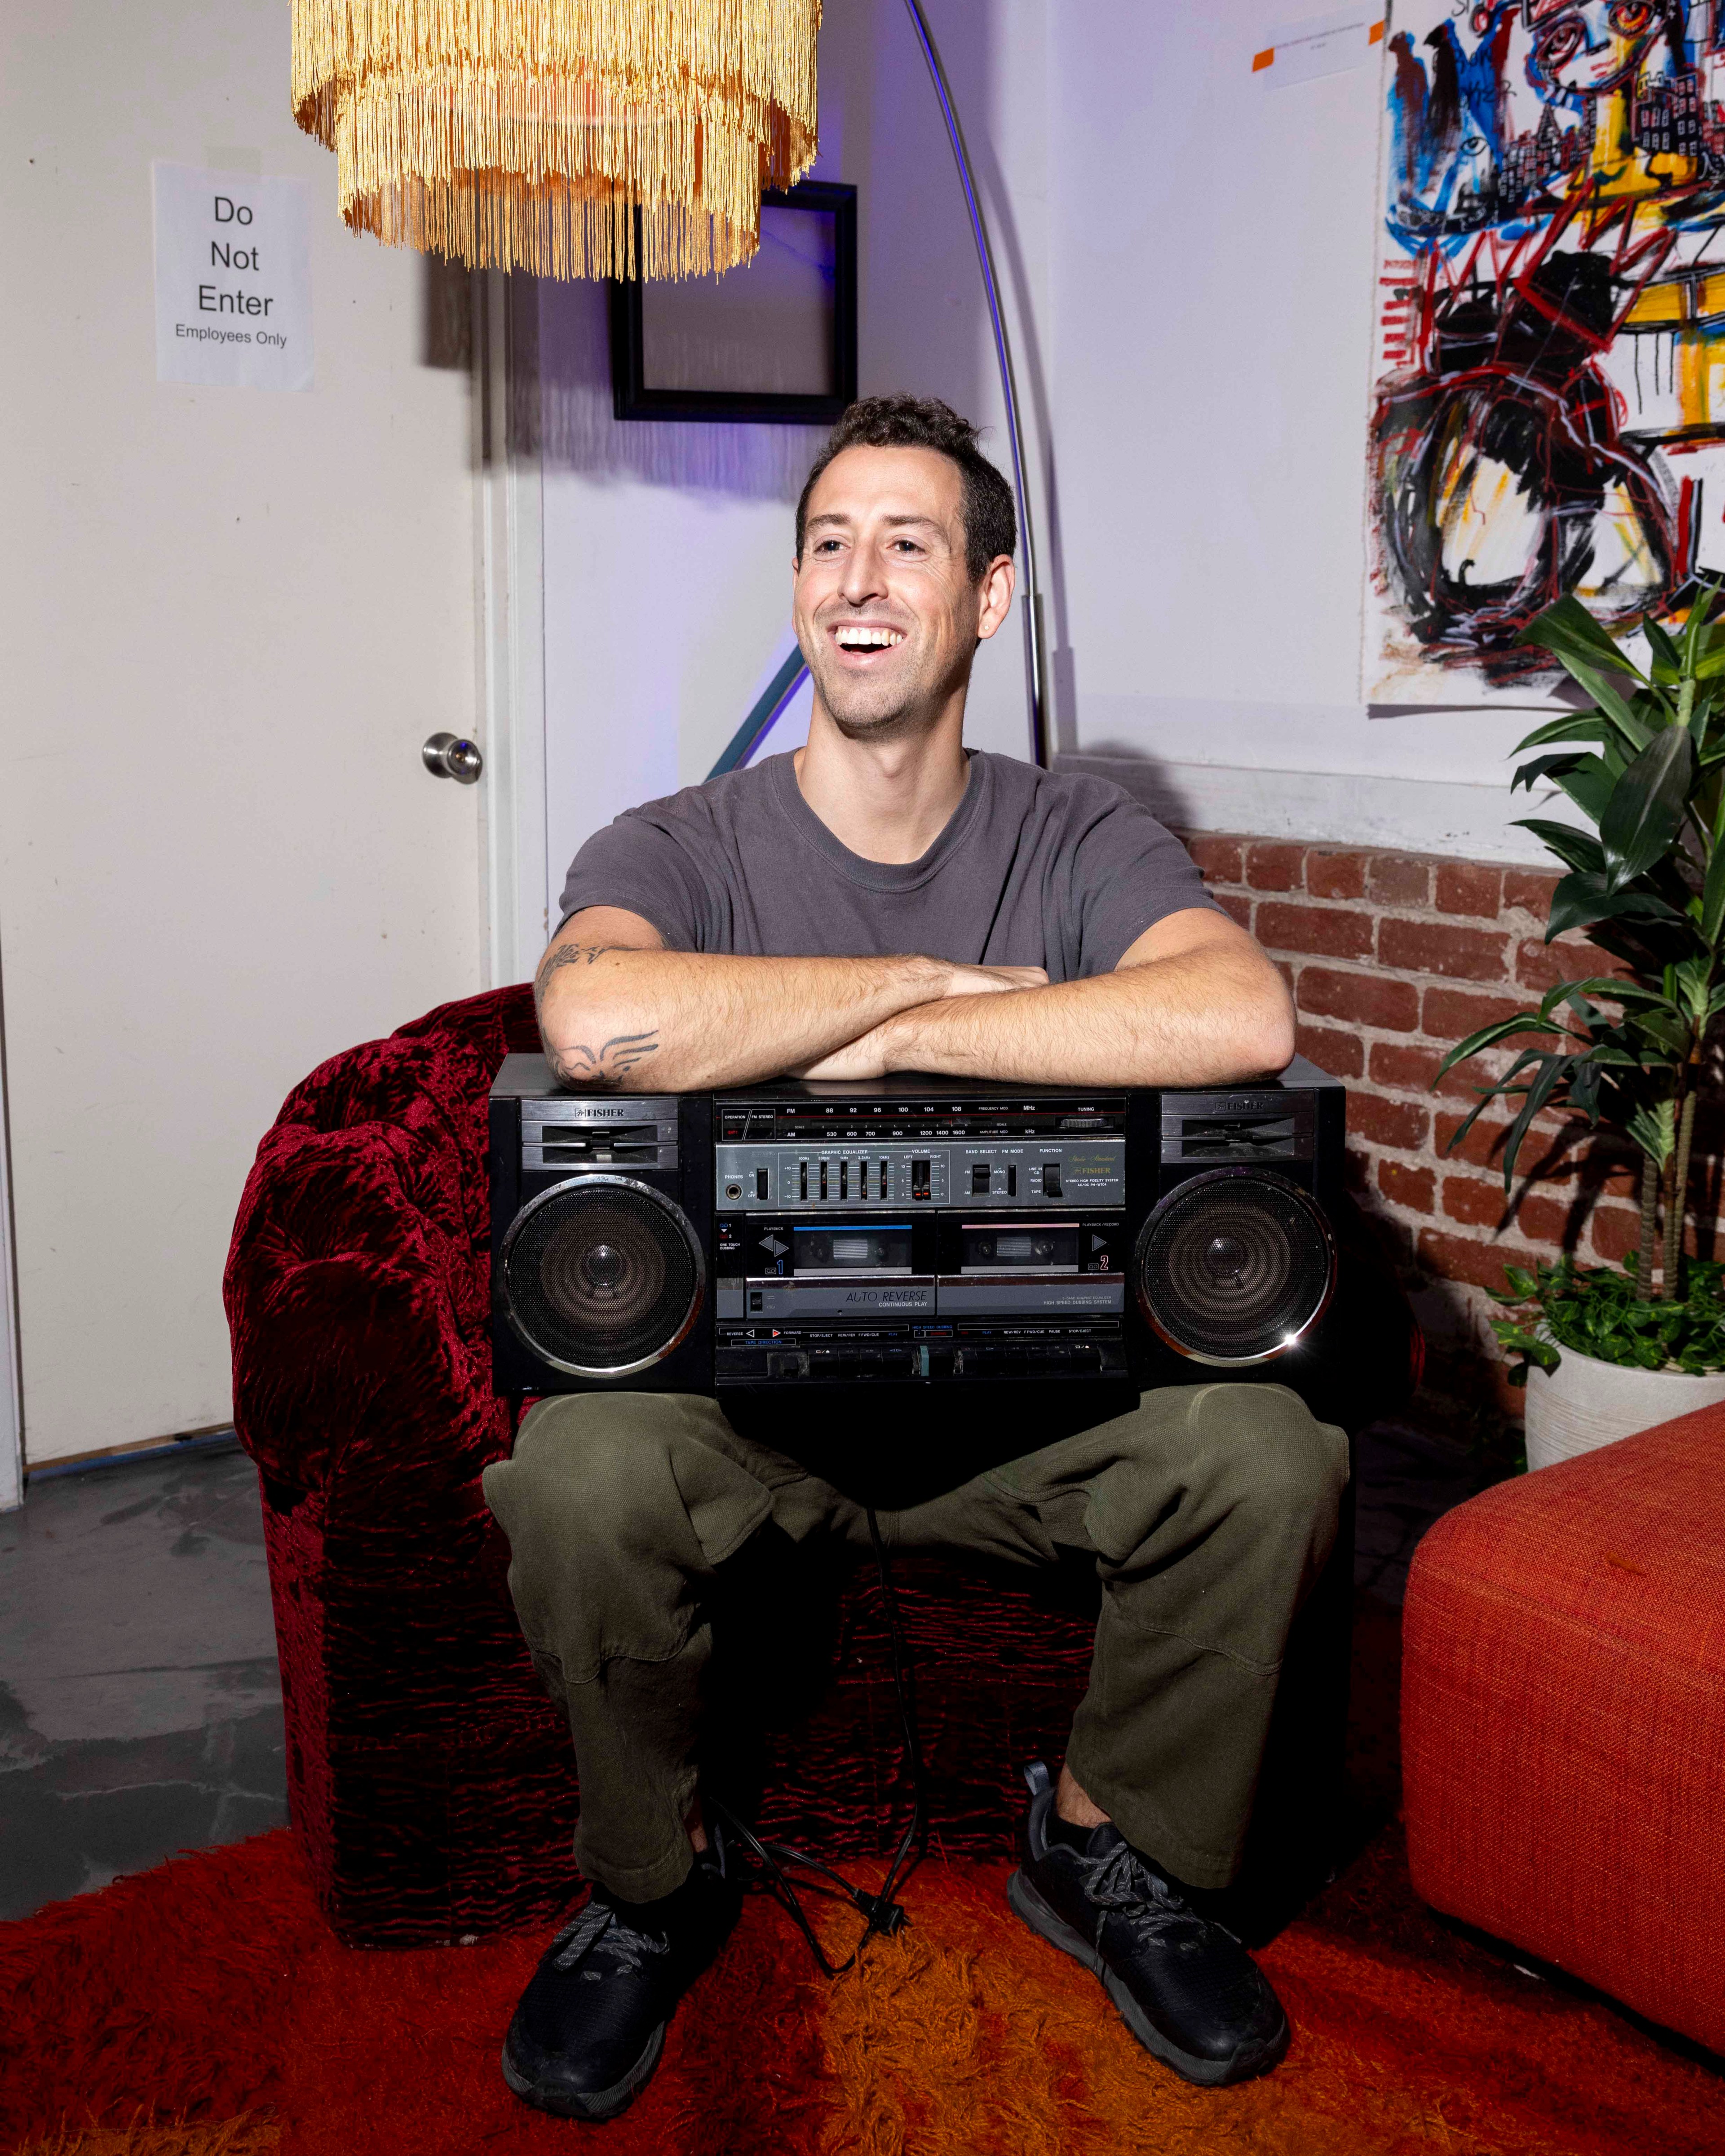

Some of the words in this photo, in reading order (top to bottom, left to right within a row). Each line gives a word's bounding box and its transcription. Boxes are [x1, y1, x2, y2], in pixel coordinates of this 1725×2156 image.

[215, 196, 252, 225] Do
[211, 241, 259, 270] Not
[199, 284, 273, 316] Enter
[176, 323, 251, 344] Employees
[257, 332, 287, 349] Only
[587, 1109, 624, 1117] FISHER
[777, 1260, 783, 1274] 1
[1100, 1255, 1108, 1270] 2
[846, 1292, 877, 1302] AUTO
[883, 1291, 927, 1301] REVERSE
